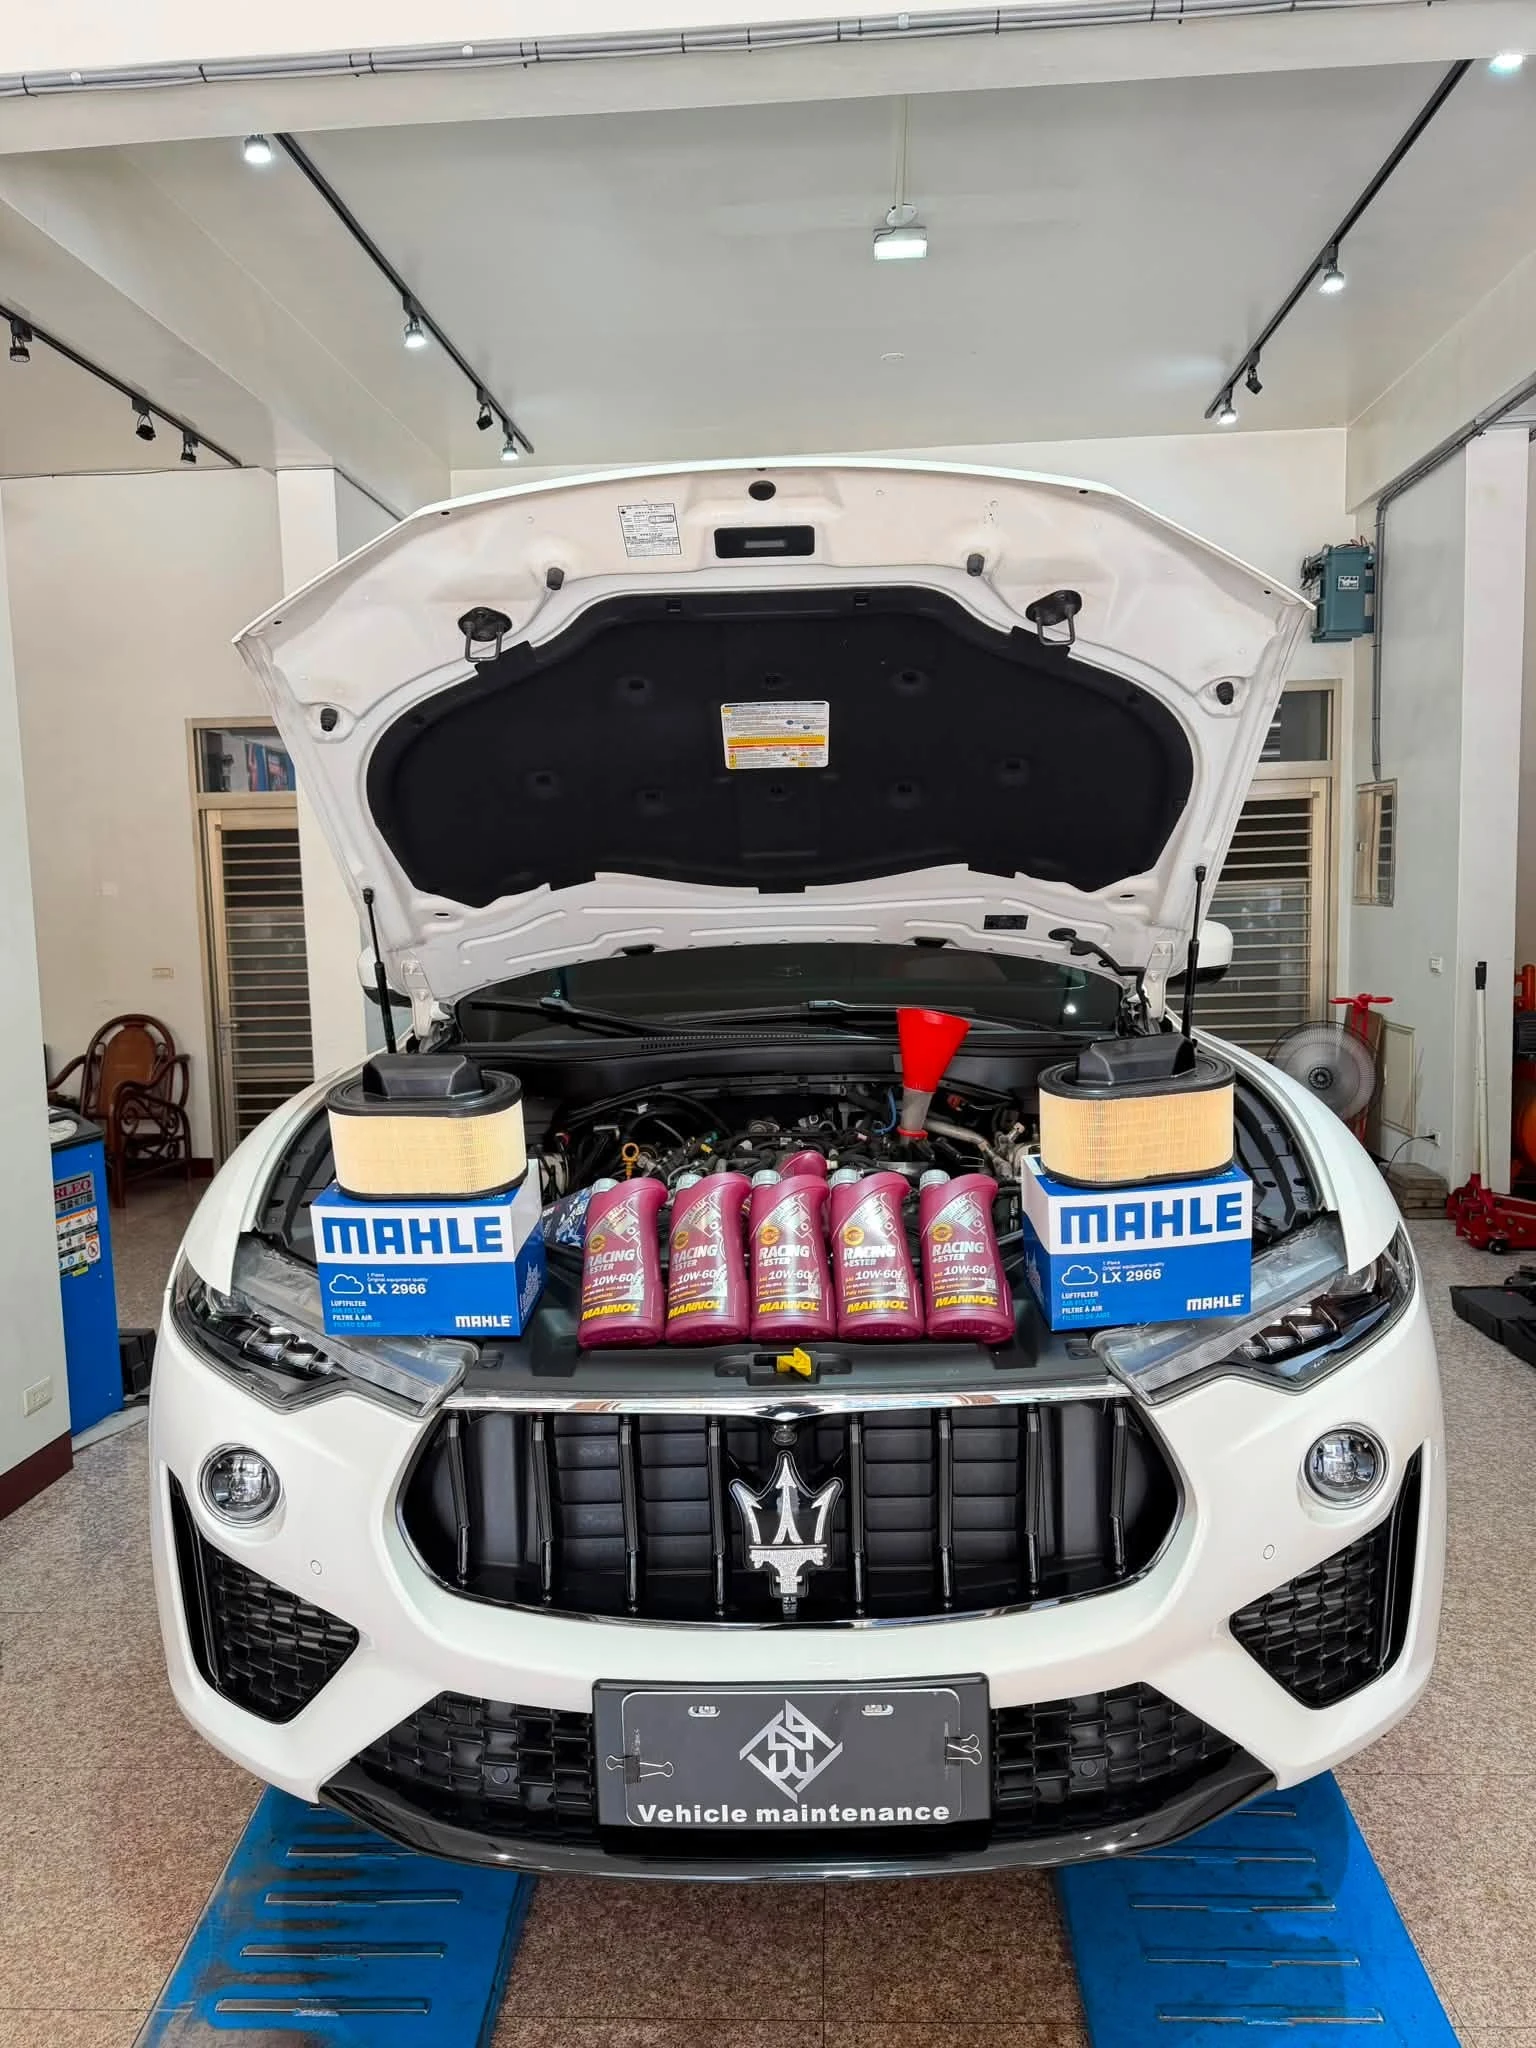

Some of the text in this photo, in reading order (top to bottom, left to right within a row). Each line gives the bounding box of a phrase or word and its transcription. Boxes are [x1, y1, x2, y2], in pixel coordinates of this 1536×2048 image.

[1060, 1192, 1242, 1245] MAHLE
[321, 1216, 503, 1255] MAHLE
[672, 1244, 718, 1264] RACING
[759, 1244, 810, 1259] RACING
[843, 1245, 896, 1260] RACING
[932, 1241, 985, 1256] RACING
[677, 1269, 717, 1285] 10W-60
[768, 1269, 810, 1280] 10W-60
[855, 1269, 898, 1280] 10W-60
[944, 1265, 987, 1276] 10W-60
[1102, 1268, 1161, 1283] LX 2966
[592, 1273, 633, 1287] 10W-60
[368, 1283, 426, 1294] LX 2966
[759, 1300, 819, 1313] MANNOL
[847, 1300, 908, 1313] MANNOL
[935, 1295, 997, 1308] MANNOL
[1187, 1294, 1242, 1312] MAHLE
[582, 1303, 640, 1321] MANNOL
[668, 1300, 721, 1320] MANNOL
[455, 1315, 512, 1328] MAHLE
[637, 1804, 951, 1823] Vehicle maintenance
